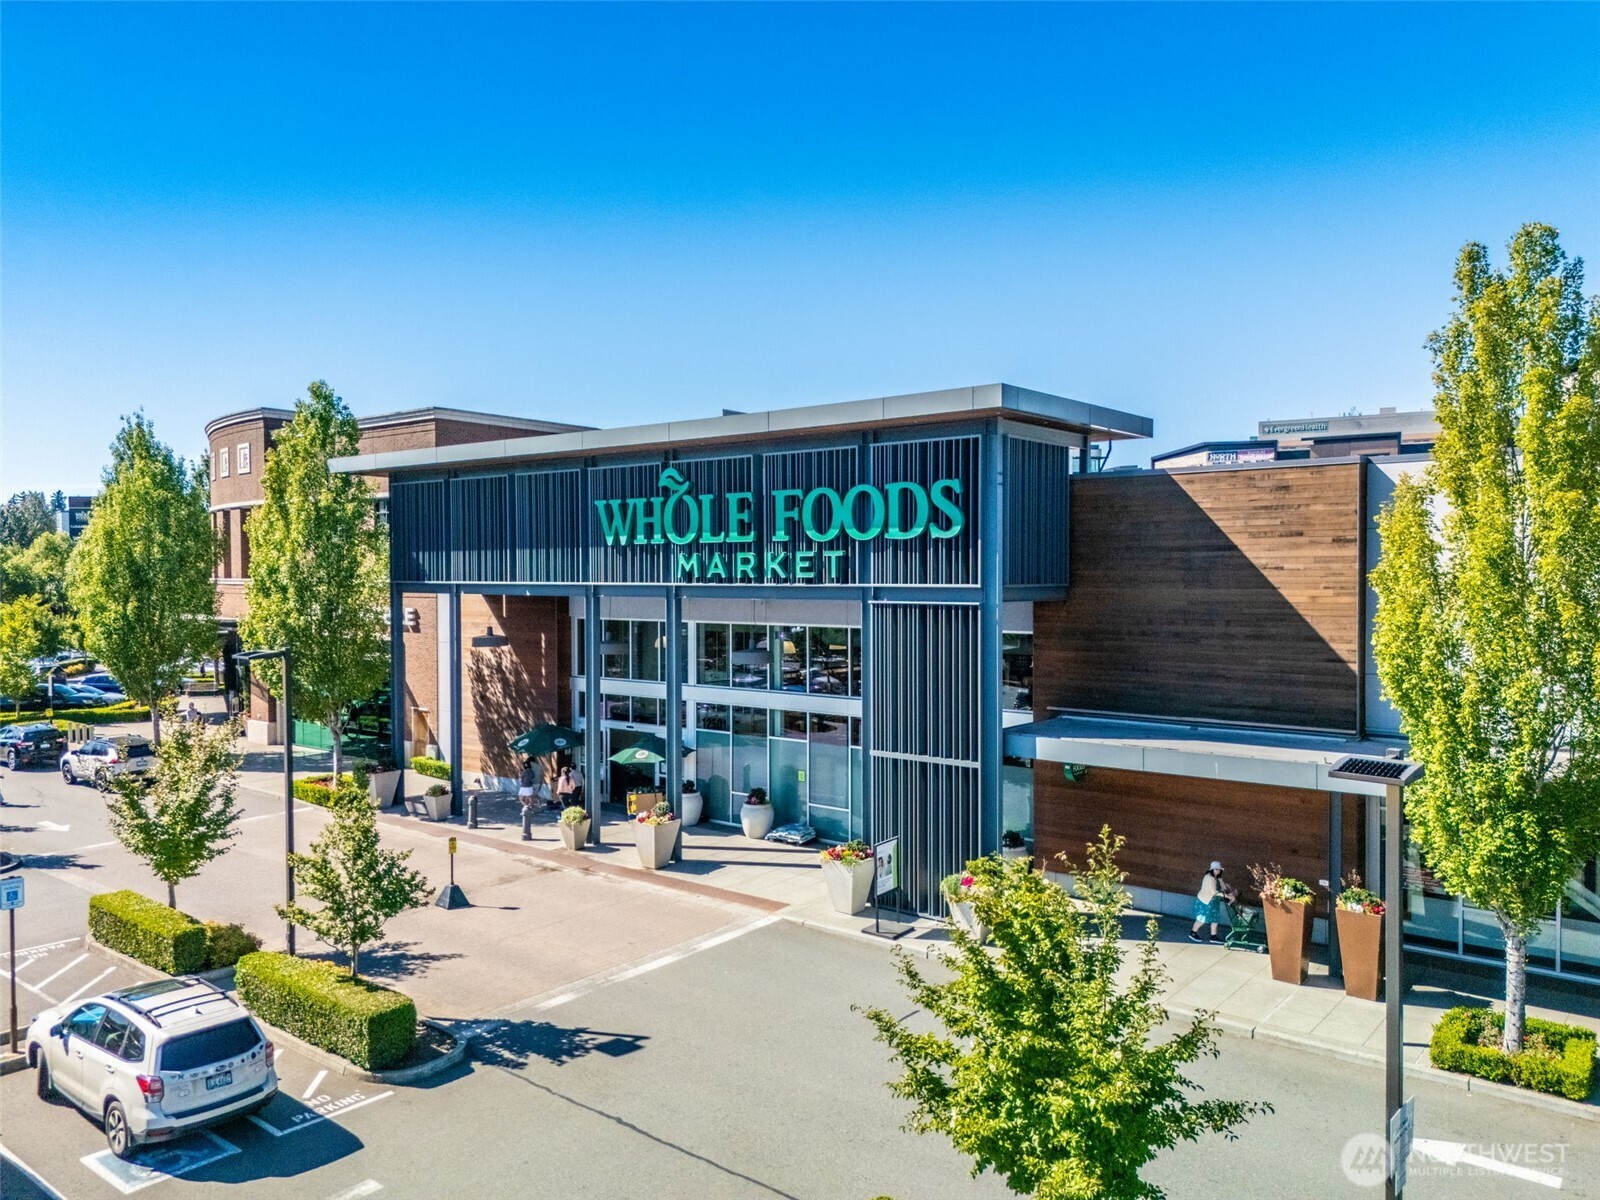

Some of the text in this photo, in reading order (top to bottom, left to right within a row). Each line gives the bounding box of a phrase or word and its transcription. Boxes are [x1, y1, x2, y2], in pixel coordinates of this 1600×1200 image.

[1270, 423, 1328, 434] EvergreenHealth
[594, 468, 965, 546] WHOLE FOODS
[676, 549, 847, 579] MARKET
[702, 717, 727, 731] 12501
[291, 1092, 366, 1123] PARKING
[304, 1094, 331, 1107] NO
